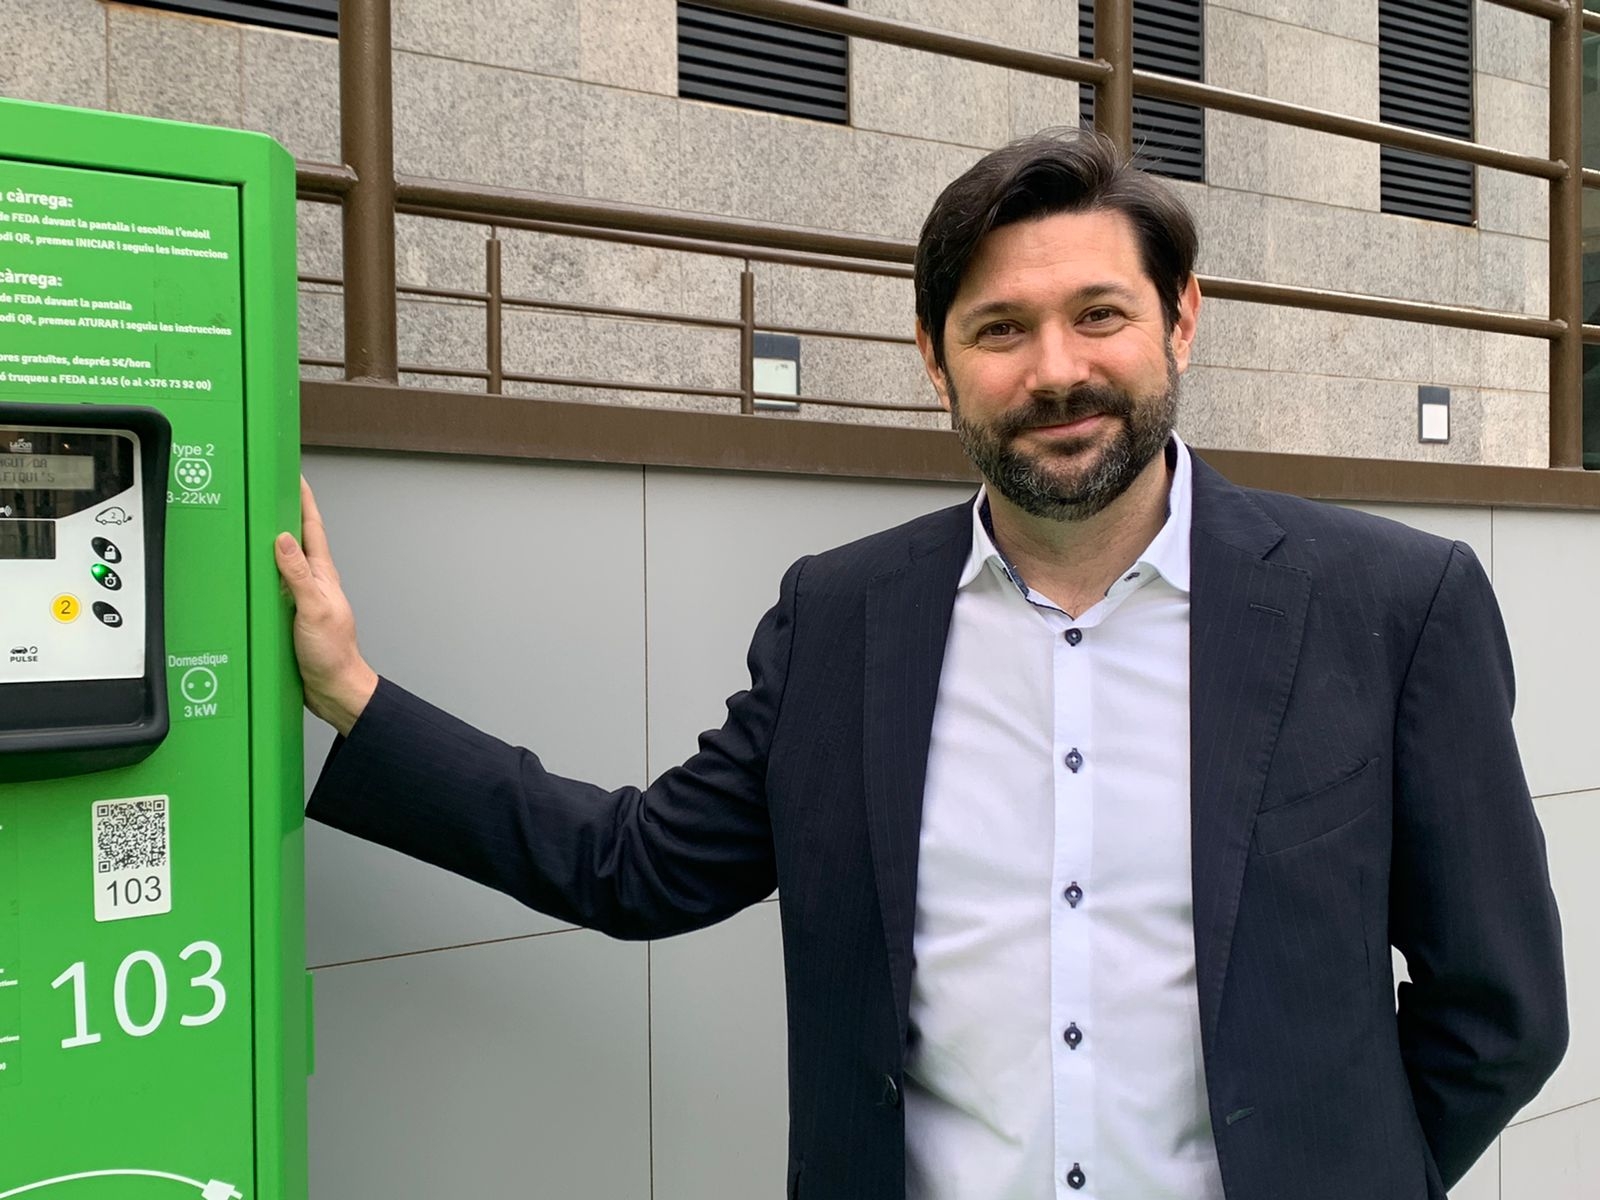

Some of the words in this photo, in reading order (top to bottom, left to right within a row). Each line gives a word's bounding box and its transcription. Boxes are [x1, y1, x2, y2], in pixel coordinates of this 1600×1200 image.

[6, 187, 73, 210] càrrega:
[11, 212, 40, 224] FEDA
[41, 215, 76, 227] davant
[77, 218, 88, 228] la
[89, 221, 130, 233] pantalla
[136, 225, 174, 237] escolliu
[15, 233, 33, 245] QR,
[35, 236, 74, 247] premeu
[75, 237, 115, 250] INICIAR
[122, 243, 154, 254] seguiu
[155, 244, 170, 254] les
[171, 245, 229, 260] instruccions
[14, 293, 42, 305] FEDA
[44, 295, 78, 307] davant
[79, 298, 90, 308] la
[91, 300, 133, 311] pantalla
[17, 313, 36, 326] QR,
[38, 316, 76, 327] premeu
[78, 317, 119, 329] ATURAR
[126, 321, 158, 333] seguiu
[159, 321, 174, 332] les
[175, 322, 232, 336] instruccions
[72, 355, 110, 368] després
[8, 372, 49, 385] truqueu
[50, 375, 57, 384] a
[59, 374, 87, 385] FEDA
[88, 375, 99, 385] al
[132, 376, 143, 388] al
[143, 378, 168, 389] +376
[168, 379, 181, 389] 73
[182, 380, 194, 390] 92
[195, 379, 212, 392] 00)
[172, 442, 202, 458] type
[206, 443, 215, 457] 2
[166, 491, 221, 505] 3-22kW
[61, 600, 71, 614] 2
[10, 655, 38, 663] PULSE
[168, 652, 228, 668] Domestique
[184, 705, 192, 718] 3
[194, 703, 217, 717] kW
[106, 875, 162, 907] 103
[51, 940, 227, 1049] 103
